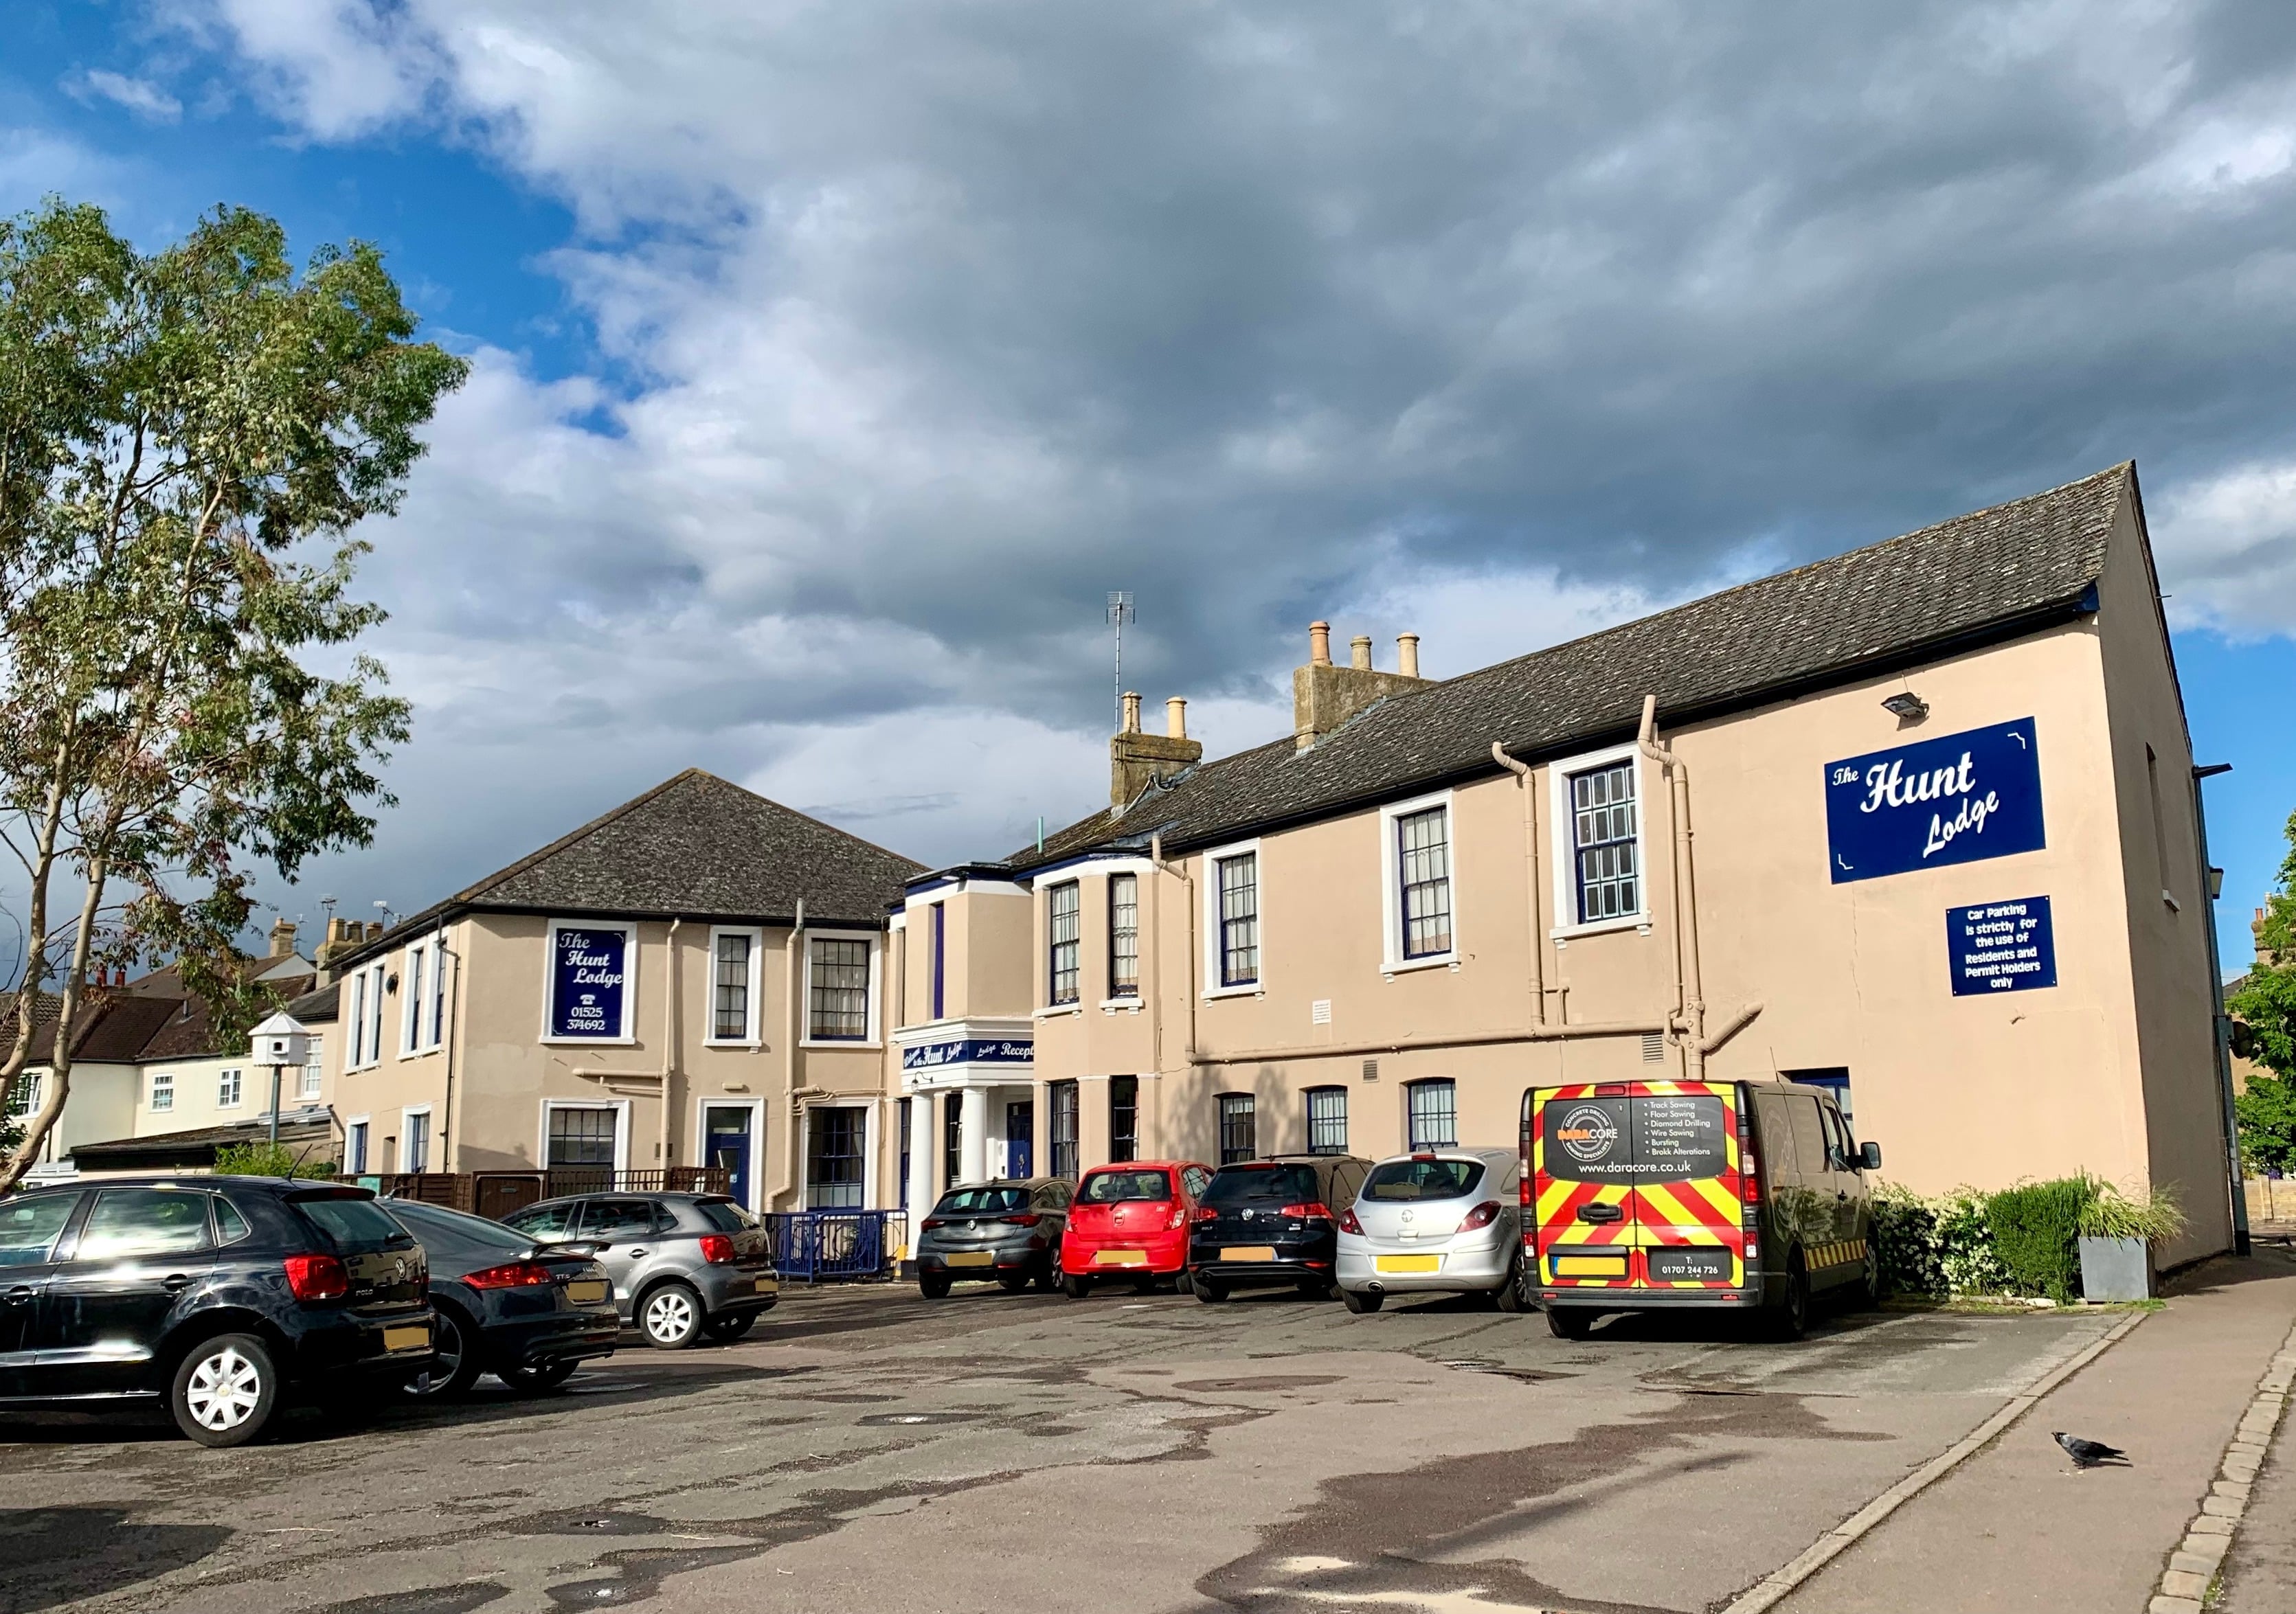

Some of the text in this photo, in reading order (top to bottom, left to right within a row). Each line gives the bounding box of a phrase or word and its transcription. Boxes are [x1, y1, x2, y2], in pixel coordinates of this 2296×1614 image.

[1832, 751, 1976, 813] The Hunt
[1923, 791, 1999, 859] Lodge
[1968, 905, 2027, 920] Car Parking
[1976, 921, 2014, 933] strictly
[2020, 918, 2038, 929] for
[559, 933, 591, 948] The
[1975, 932, 2029, 948] the use of
[565, 951, 610, 966] Hunt
[1966, 946, 2038, 964] Residents and
[1966, 962, 2041, 977] Permit Holders
[573, 968, 622, 989] Lodge
[1990, 977, 2013, 988] only
[571, 1007, 603, 1018] 01525
[567, 1020, 605, 1031] 374692
[923, 1046, 944, 1065] Hunt
[945, 1042, 962, 1062] Lodge
[976, 1043, 1034, 1059] Lodge Recept
[1669, 1101, 1696, 1110] Sawing
[1566, 1109, 1610, 1128] CONCRETE DRILLING
[1669, 1111, 1696, 1119] Sawing
[1685, 1119, 1711, 1128] Drilling
[1669, 1129, 1694, 1138] Sawing
[1566, 1141, 1610, 1159] SAWING SPECIALISTS
[1651, 1139, 1679, 1148] Bursting
[1579, 1160, 1691, 1173] www.daracore.co.uk
[1662, 1266, 1718, 1274] 01707 244 726
